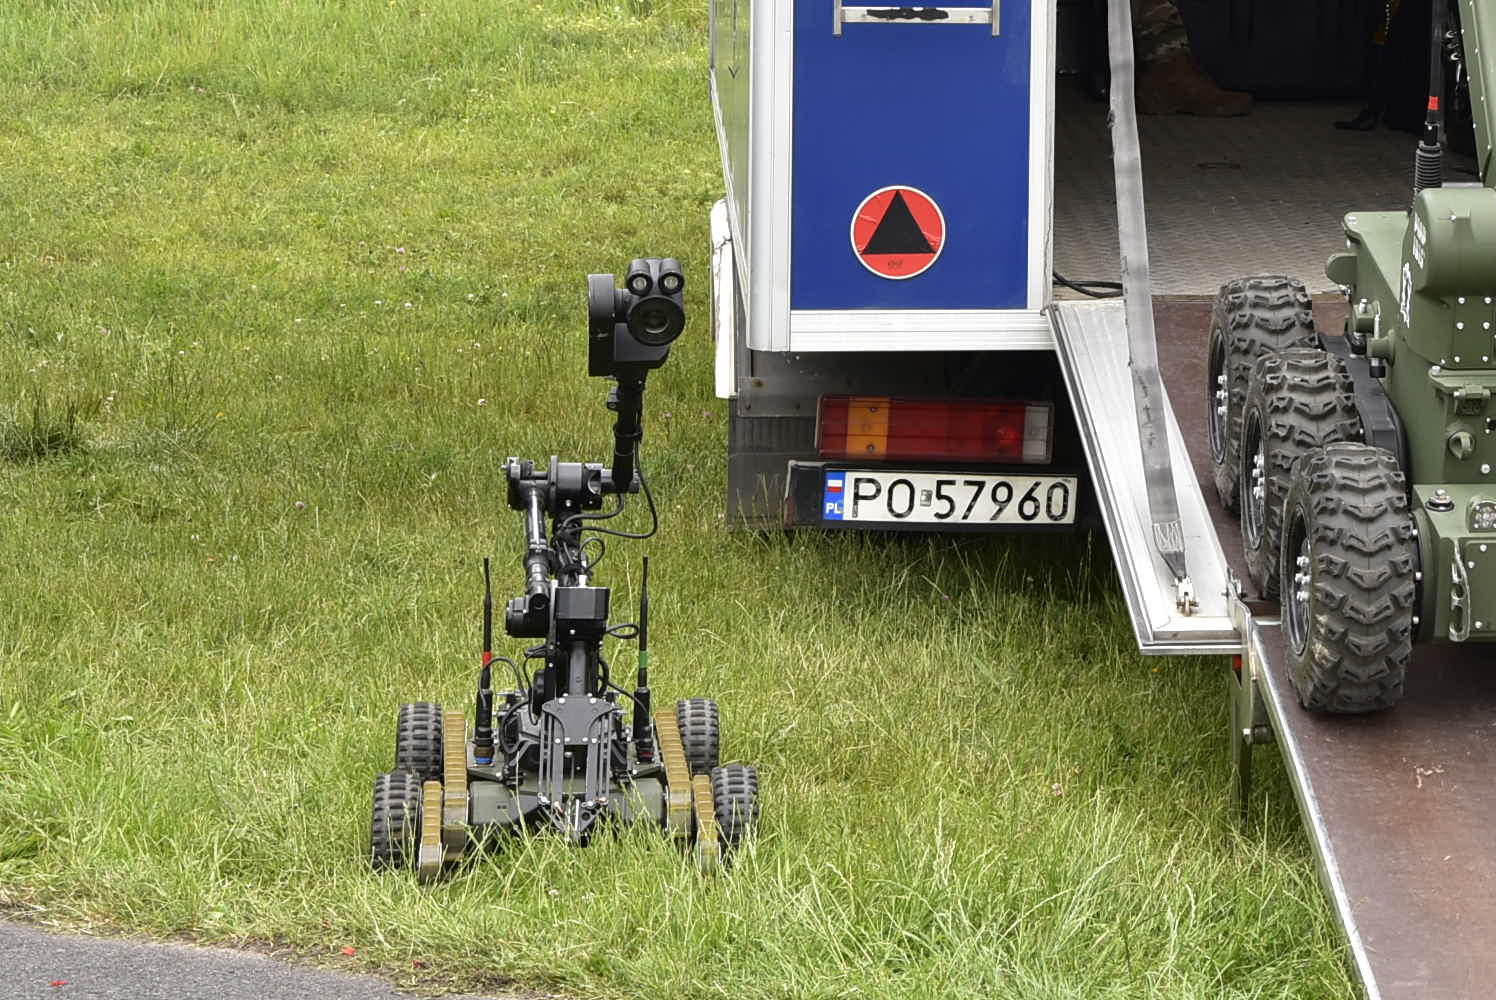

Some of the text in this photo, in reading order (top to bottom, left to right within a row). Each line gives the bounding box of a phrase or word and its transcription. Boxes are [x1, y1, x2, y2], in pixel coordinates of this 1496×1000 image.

[825, 503, 842, 514] PL
[852, 477, 1069, 522] PO 57960
